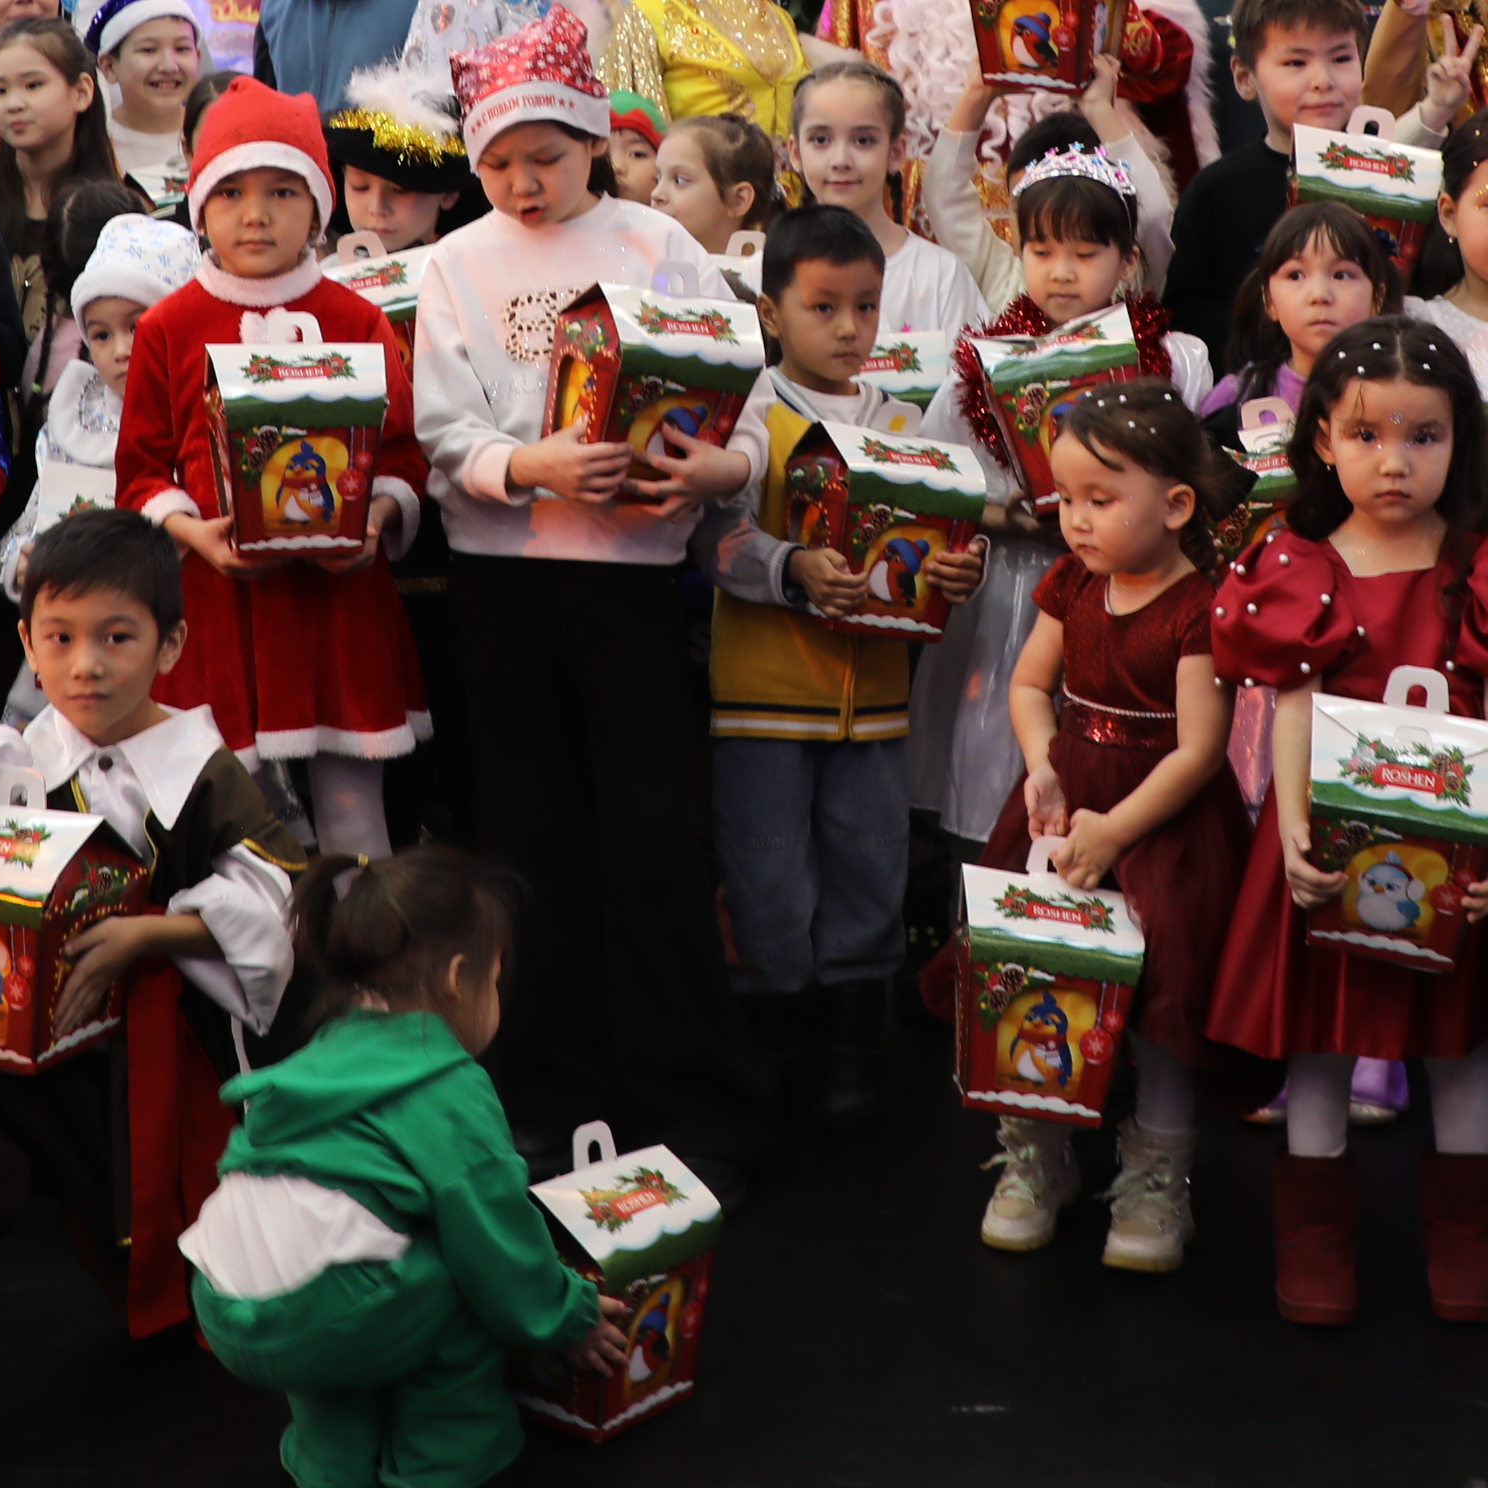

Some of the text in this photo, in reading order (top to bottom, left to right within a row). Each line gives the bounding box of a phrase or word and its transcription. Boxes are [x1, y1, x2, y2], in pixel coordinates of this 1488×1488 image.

[521, 94, 557, 110] ГОДОМ!
[1349, 158, 1389, 172] ROSHEN
[667, 320, 710, 334] ROSHEN
[1381, 768, 1436, 788] ROSHEN
[1033, 905, 1082, 923] ROSHEN
[617, 1192, 656, 1213] ROSHEN
